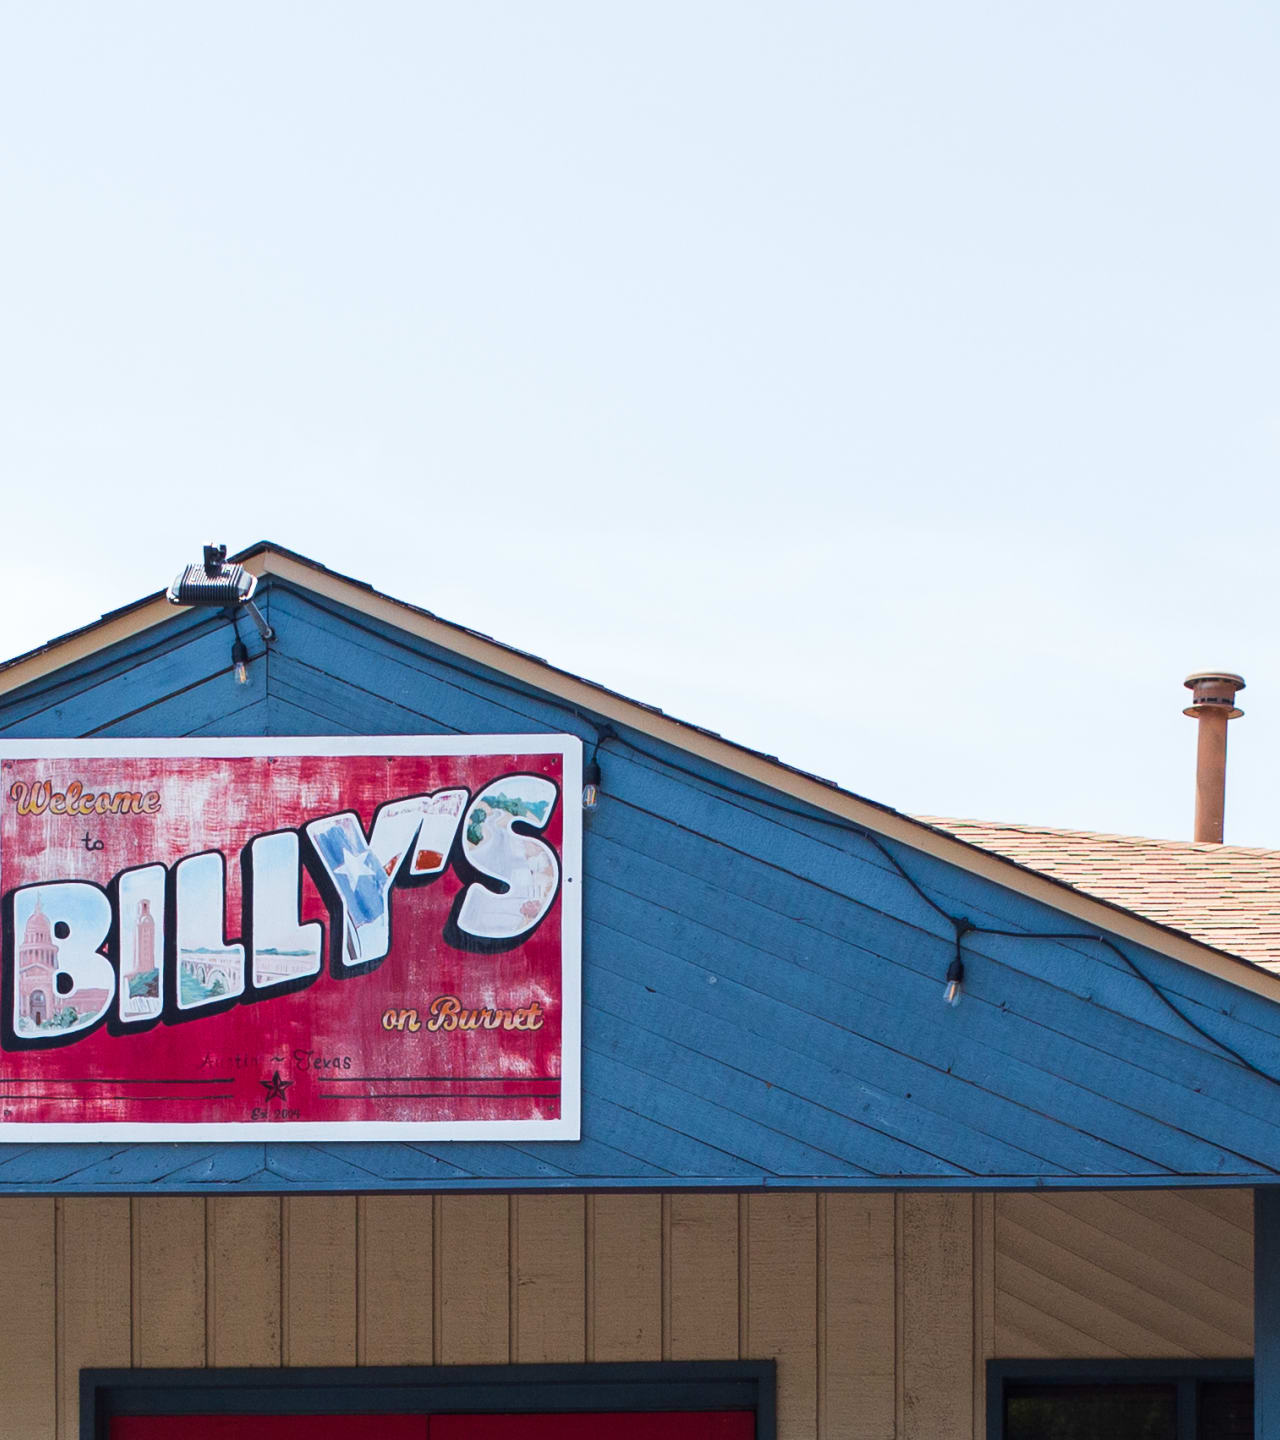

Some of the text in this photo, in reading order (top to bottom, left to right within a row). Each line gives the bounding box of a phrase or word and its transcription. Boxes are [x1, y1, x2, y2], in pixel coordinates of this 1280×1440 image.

[10, 780, 161, 816] Welcome
[81, 832, 105, 851] to
[0, 771, 559, 1052] BILLY'S
[382, 994, 545, 1033] on Burnet
[293, 1049, 352, 1071] Texas
